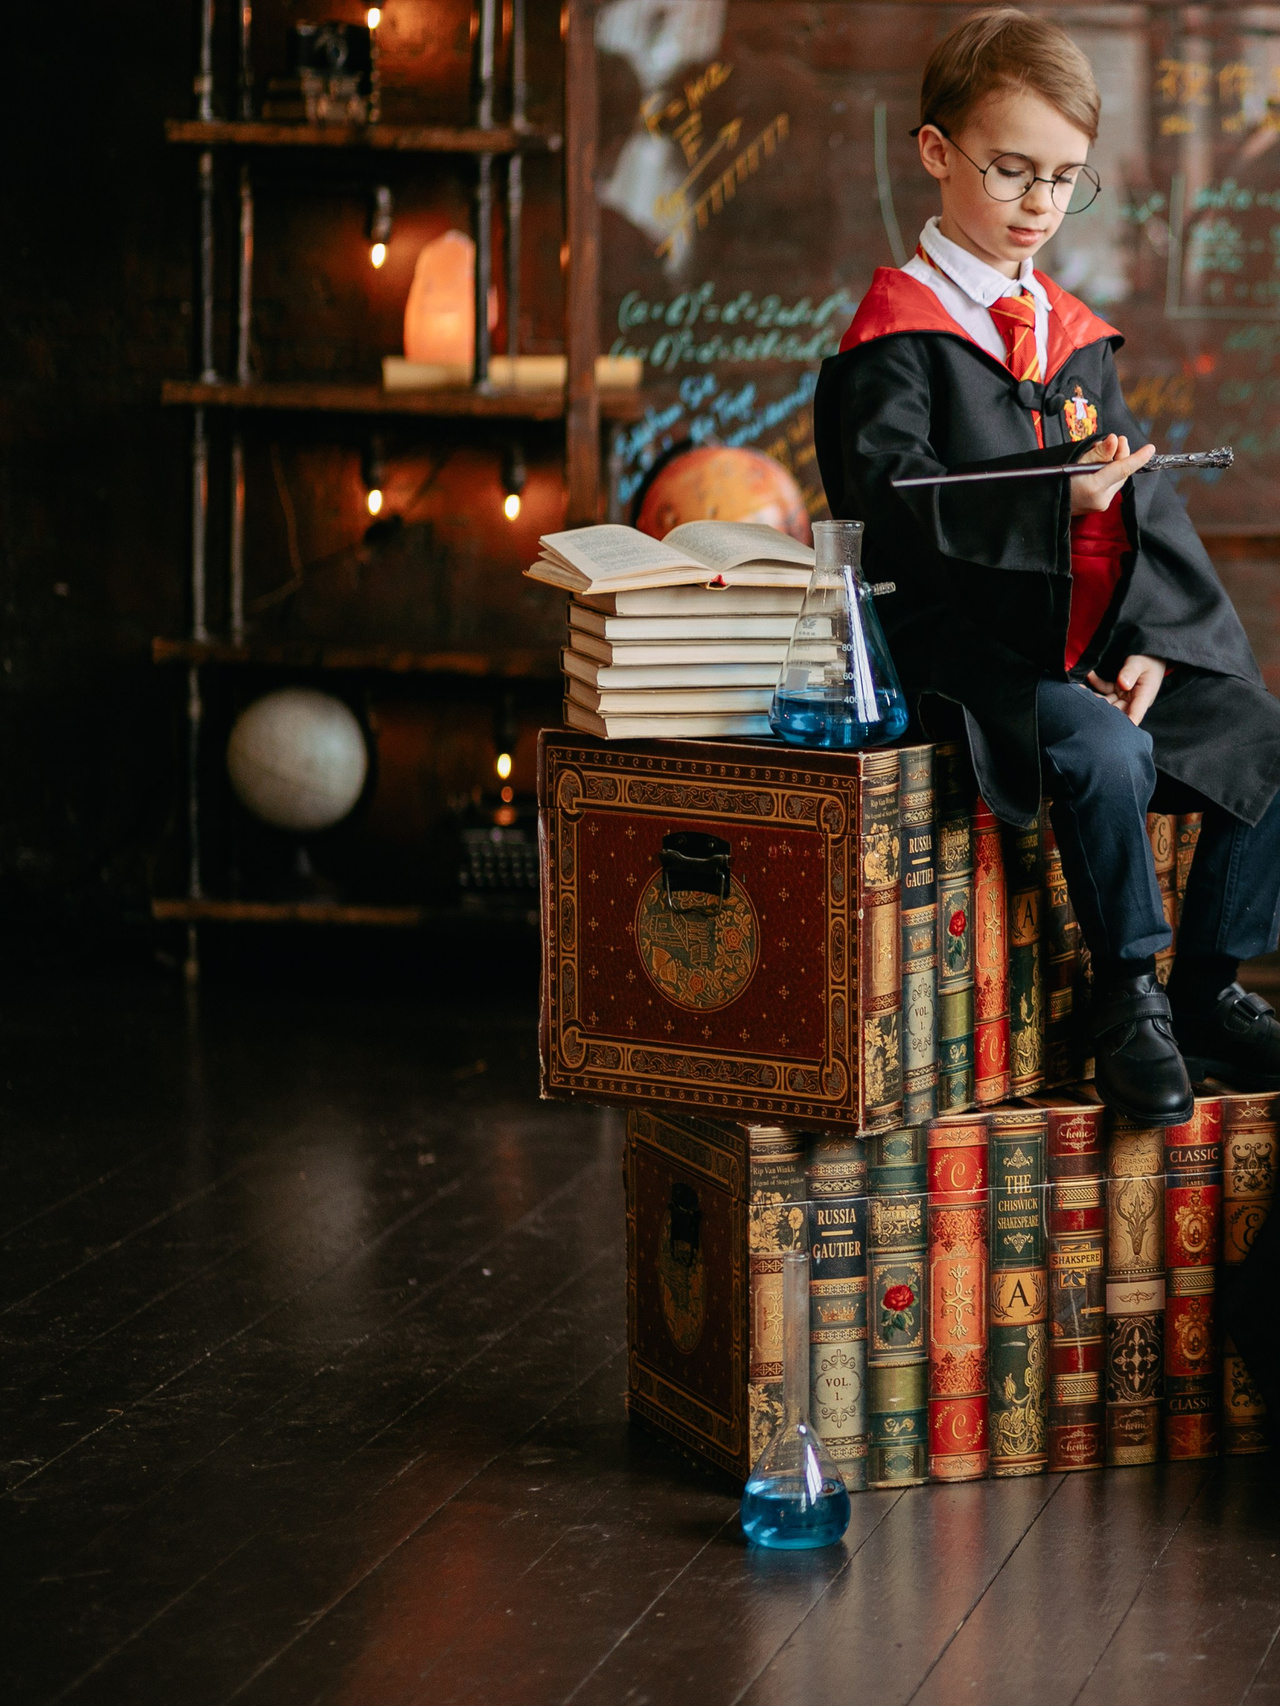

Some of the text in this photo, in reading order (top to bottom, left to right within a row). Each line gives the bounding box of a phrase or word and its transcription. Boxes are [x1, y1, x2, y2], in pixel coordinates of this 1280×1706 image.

[909, 834, 933, 854] RUSSIA
[1060, 1127, 1095, 1139] home
[1169, 1147, 1219, 1163] CLASSIC
[752, 1165, 796, 1177] Rip Van Winkle
[1117, 1163, 1158, 1174] MAGAZINE
[753, 1180, 771, 1188] Legend
[1004, 1173, 1032, 1195] THE
[998, 1197, 1039, 1213] CHISWICK
[817, 1208, 857, 1226] RUSSIA
[997, 1214, 1039, 1230] SHAKESPEARE
[812, 1240, 862, 1260] GAUTIER
[1052, 1252, 1101, 1266] SHAKSPERE
[1006, 1278, 1032, 1309] A
[825, 1377, 852, 1388] VOL.
[1169, 1396, 1214, 1411] CLASSIC
